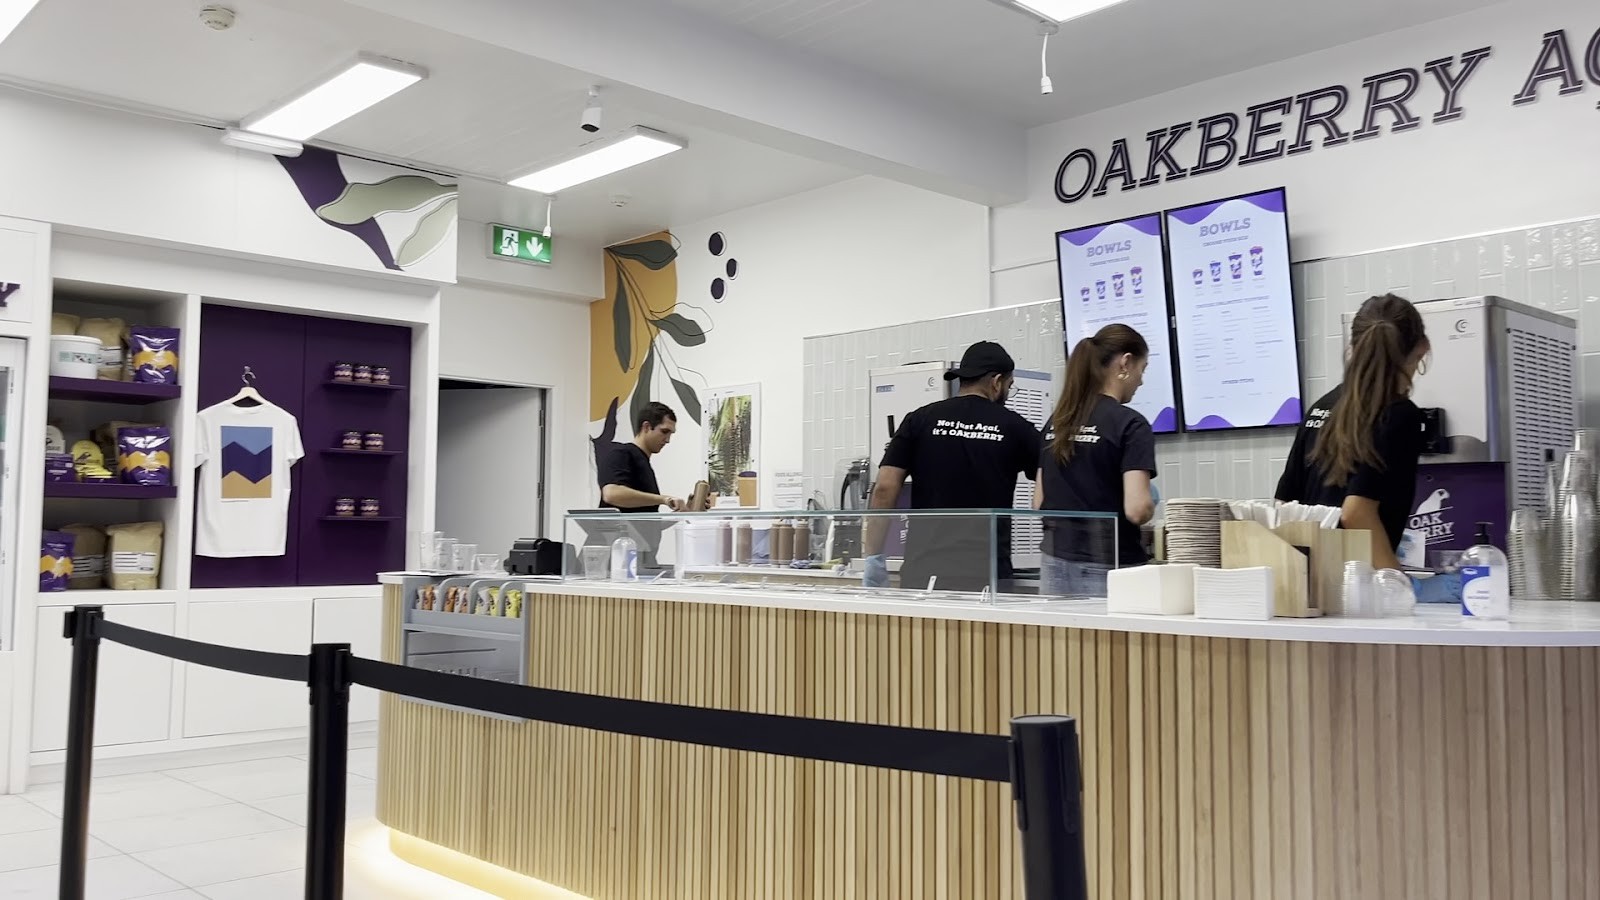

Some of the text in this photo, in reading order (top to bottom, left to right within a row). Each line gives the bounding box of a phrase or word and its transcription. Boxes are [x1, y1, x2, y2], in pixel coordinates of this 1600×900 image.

[1054, 45, 1491, 205] OAKBERRY
[1199, 217, 1252, 238] BOWLS
[1086, 240, 1133, 258] BOWLS
[955, 421, 974, 429] just
[949, 429, 1004, 441] OAKBERRY
[1409, 512, 1443, 529] OAK
[1419, 522, 1455, 538] RRY
